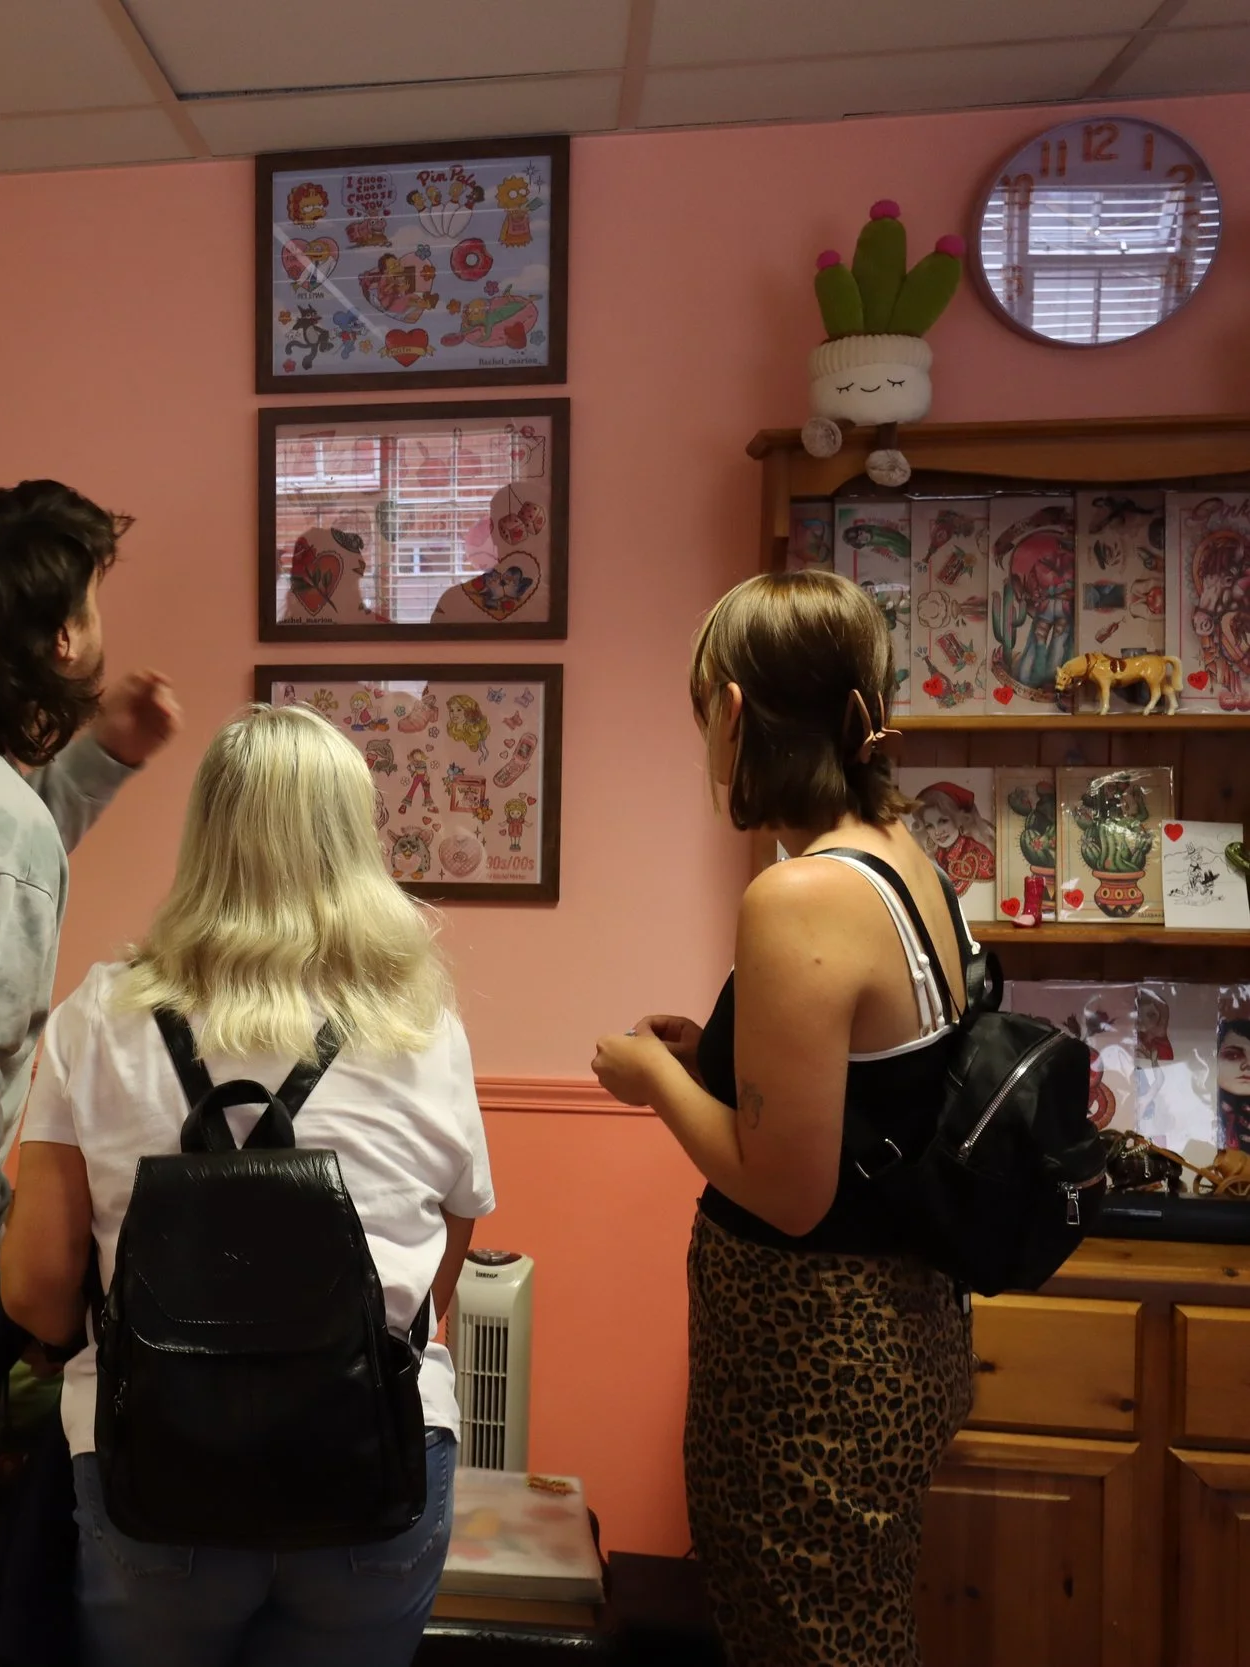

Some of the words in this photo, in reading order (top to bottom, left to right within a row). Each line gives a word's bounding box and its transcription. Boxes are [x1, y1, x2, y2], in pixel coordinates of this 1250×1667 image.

[1041, 139, 1067, 177] 11
[1082, 122, 1119, 161] 12
[1144, 132, 1154, 170] 1
[347, 190, 393, 204] CHOOSE
